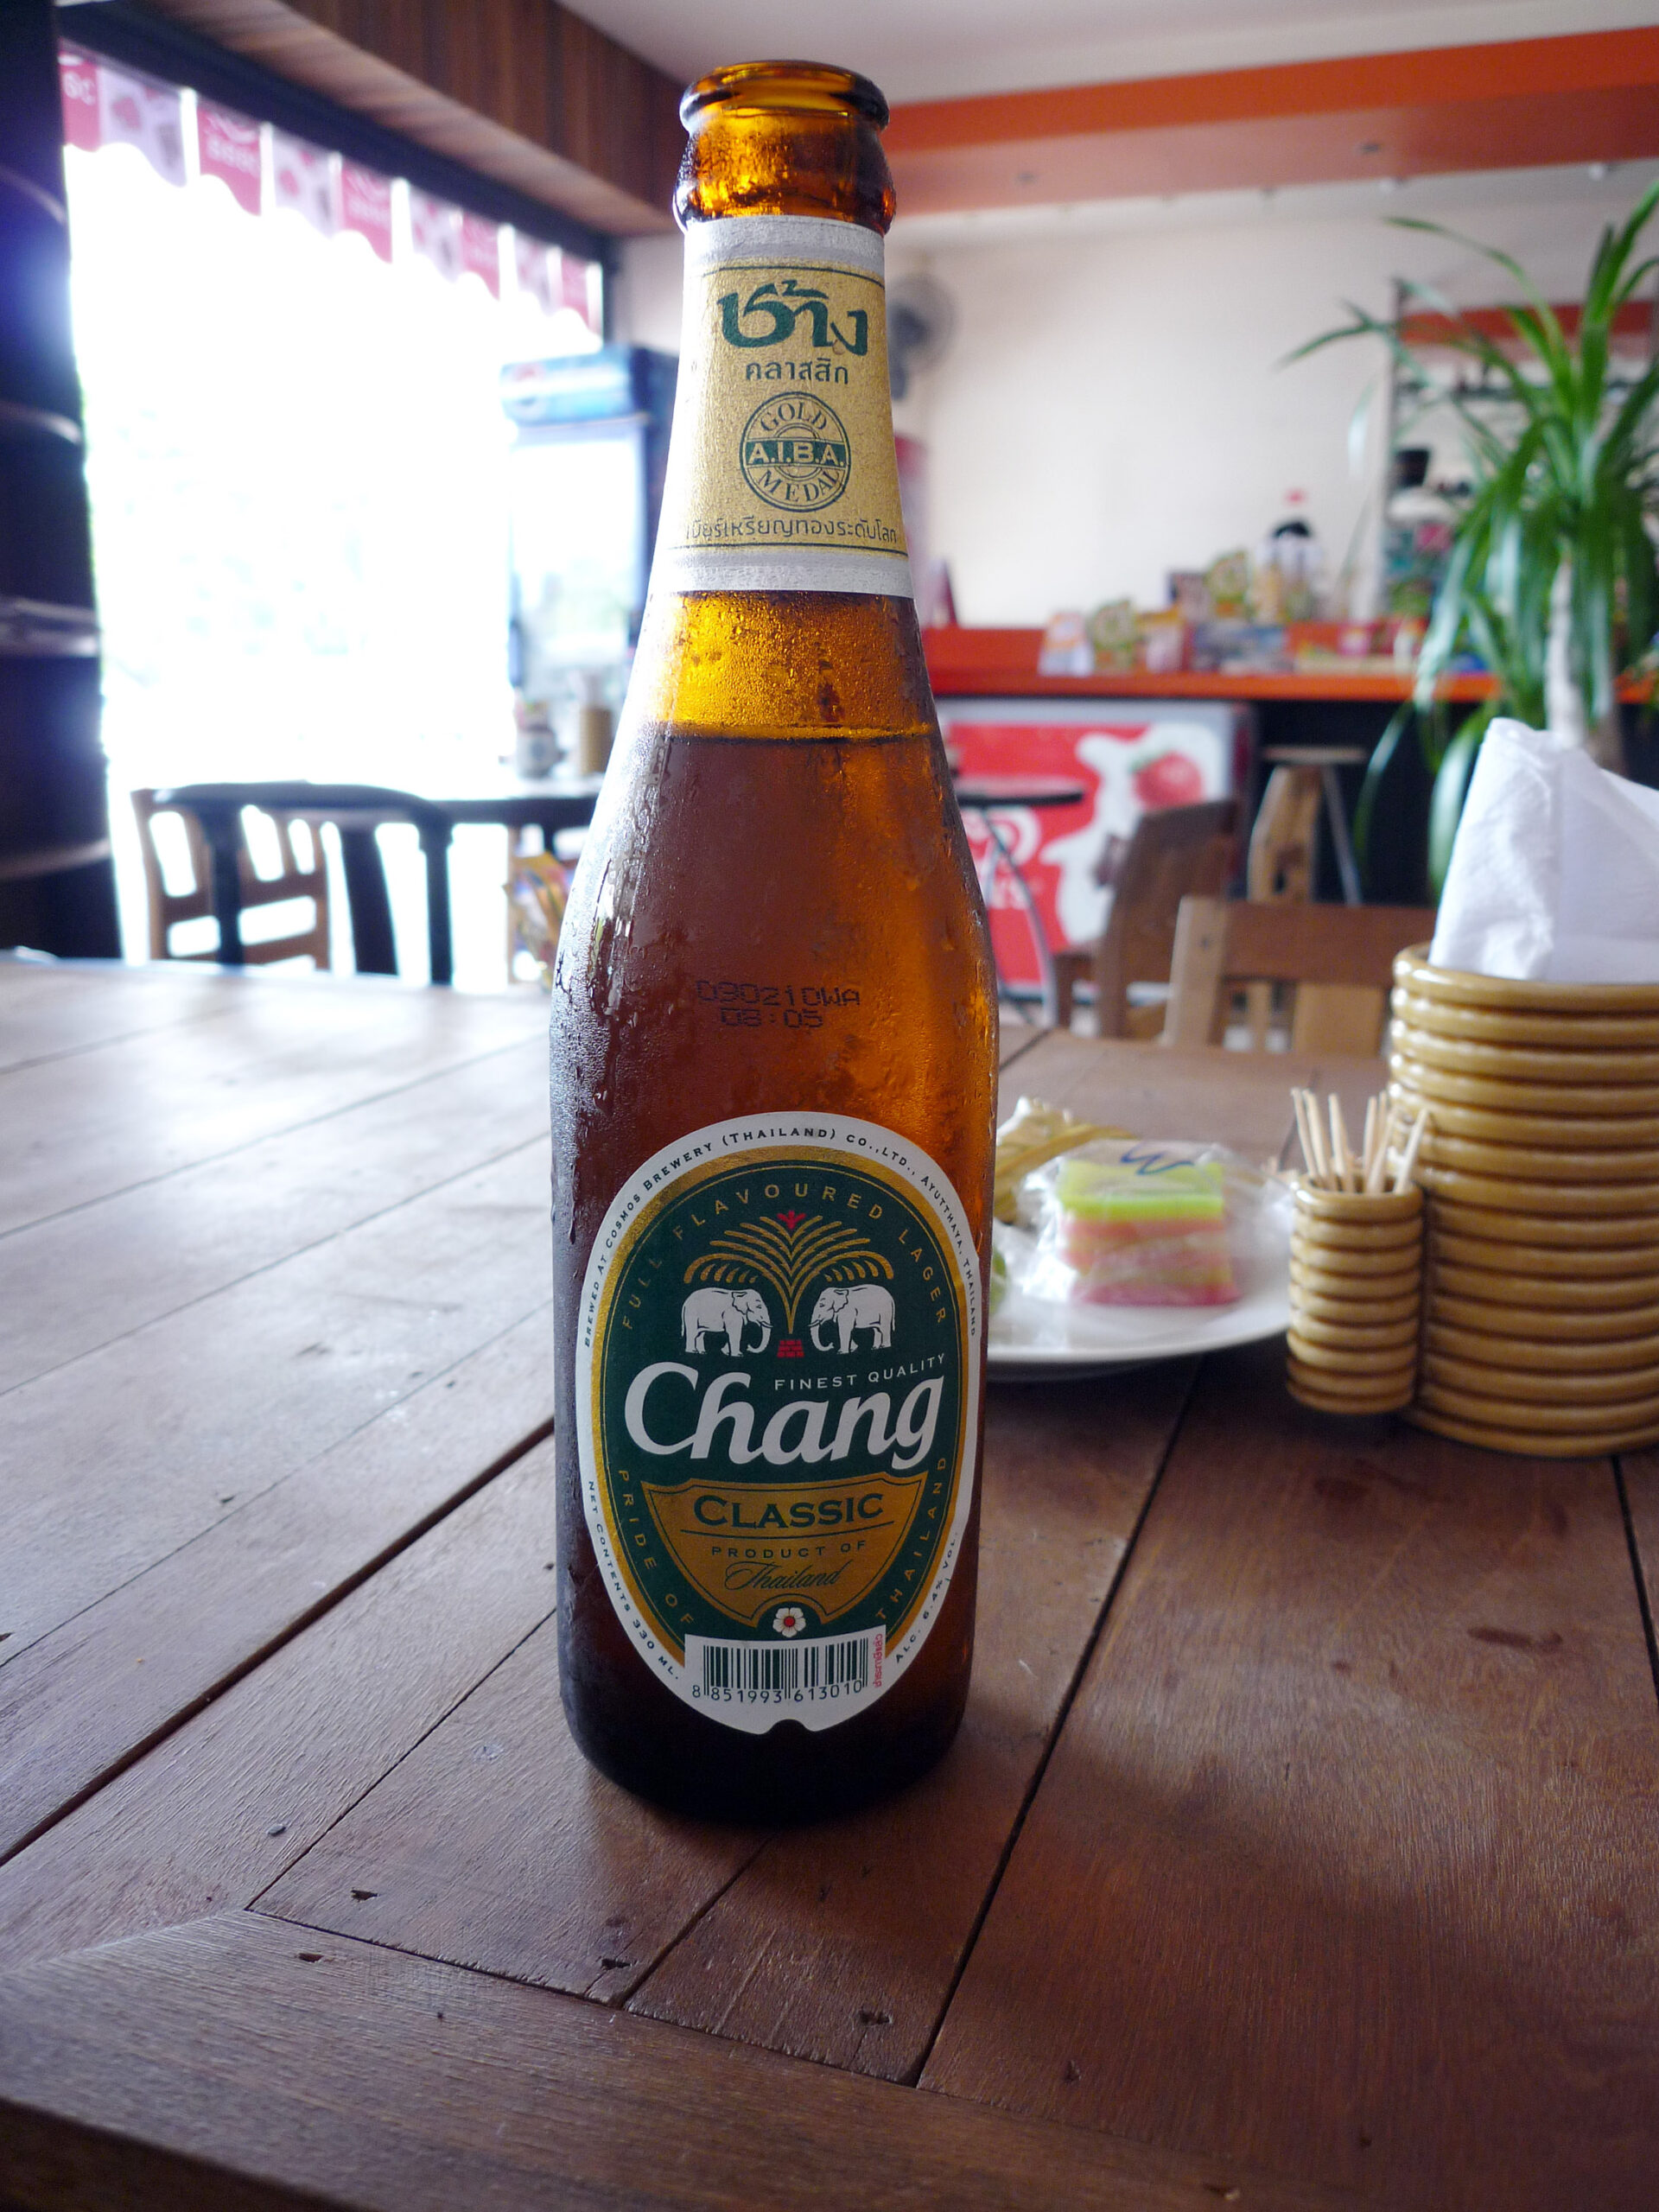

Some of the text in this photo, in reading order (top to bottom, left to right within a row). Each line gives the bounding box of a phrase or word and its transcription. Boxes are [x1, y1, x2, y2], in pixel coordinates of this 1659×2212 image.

[716, 279, 868, 356] ช้าง
[746, 358, 849, 385] คลาสสิก
[760, 402, 827, 431] GOLD
[748, 442, 844, 467] A.I.B.A.
[759, 469, 841, 502] MEDAL
[585, 1281, 600, 1347] BREWED
[597, 1255, 607, 1274] AT
[606, 1193, 640, 1249] COSMOS
[643, 1142, 713, 1191] BREWERY
[722, 1128, 836, 1147] (THAILAND)
[963, 1258, 976, 1336] THAILAND
[622, 1183, 946, 1330] FULL FLAVOURED LAGER
[774, 1352, 945, 1391] FINEST QUALITY
[624, 1361, 944, 1470] Chang
[693, 1493, 884, 1529] CLASSIC
[618, 1458, 946, 1625] PRIDE OF THAILAND
[711, 1541, 867, 1559] PRODUCT OF
[588, 1481, 679, 1679] NET CONTENTS 330 ML.
[724, 1559, 854, 1591] Thailand
[896, 1630, 922, 1663] ALC.
[923, 1580, 944, 1620] 6.4%
[692, 1680, 862, 1703] 8 851993 613010
